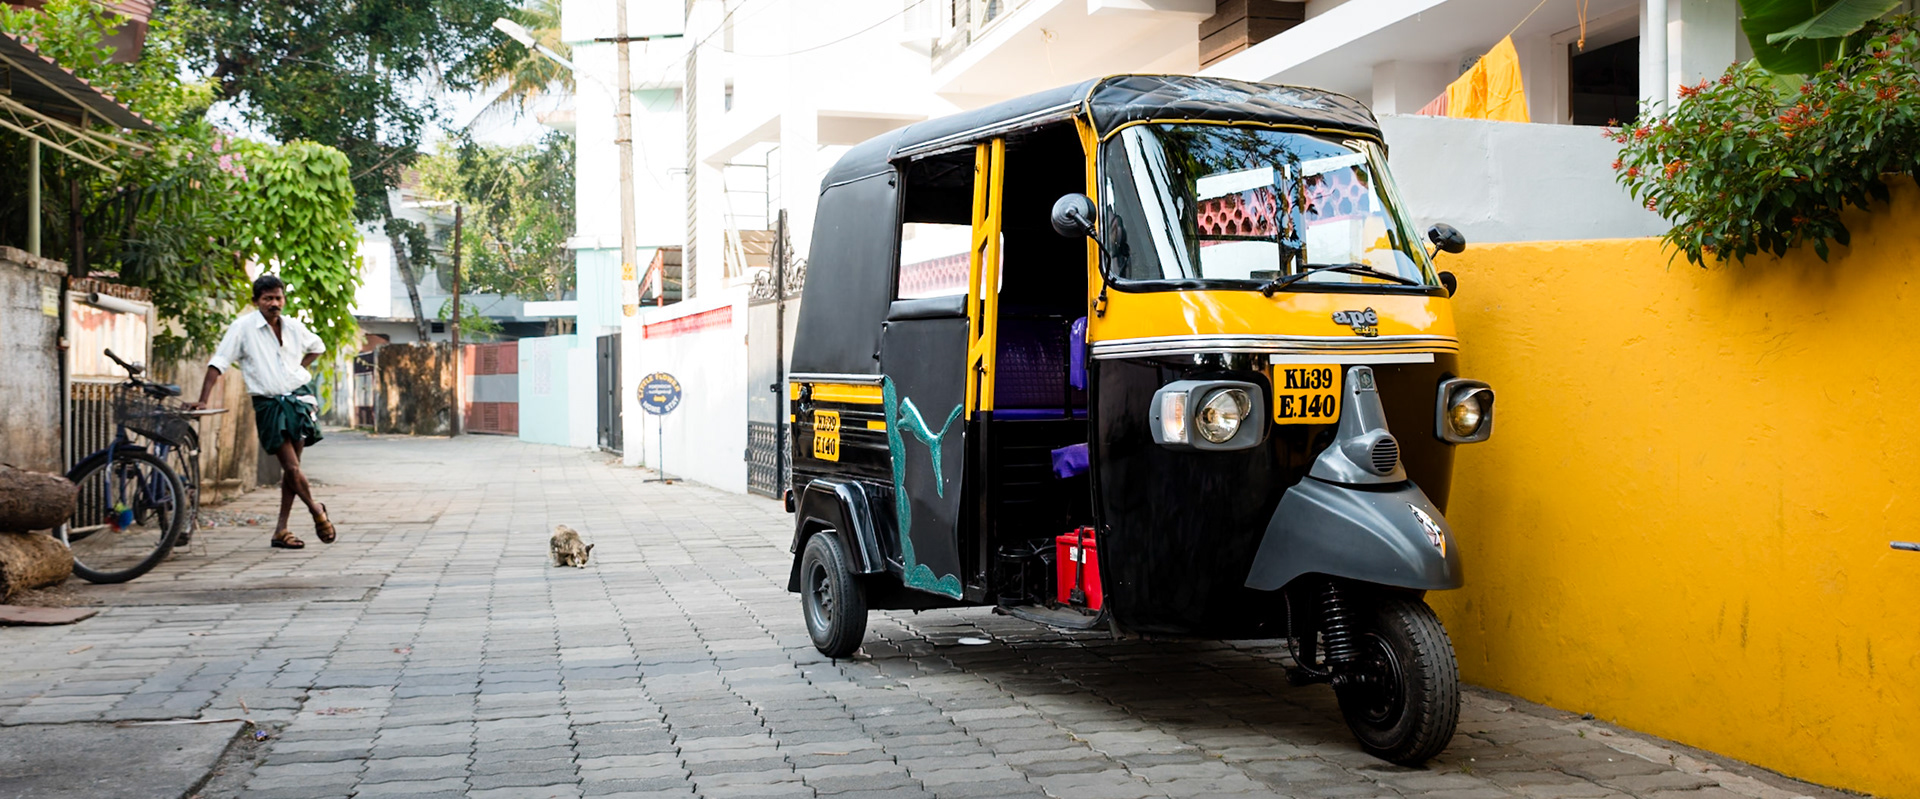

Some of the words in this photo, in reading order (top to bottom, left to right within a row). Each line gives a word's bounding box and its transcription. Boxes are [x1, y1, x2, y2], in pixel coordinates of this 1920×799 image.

[638, 375, 654, 400] LITTLE
[655, 373, 681, 392] FLOWER
[642, 400, 661, 414] HOME
[665, 395, 679, 412] STAY
